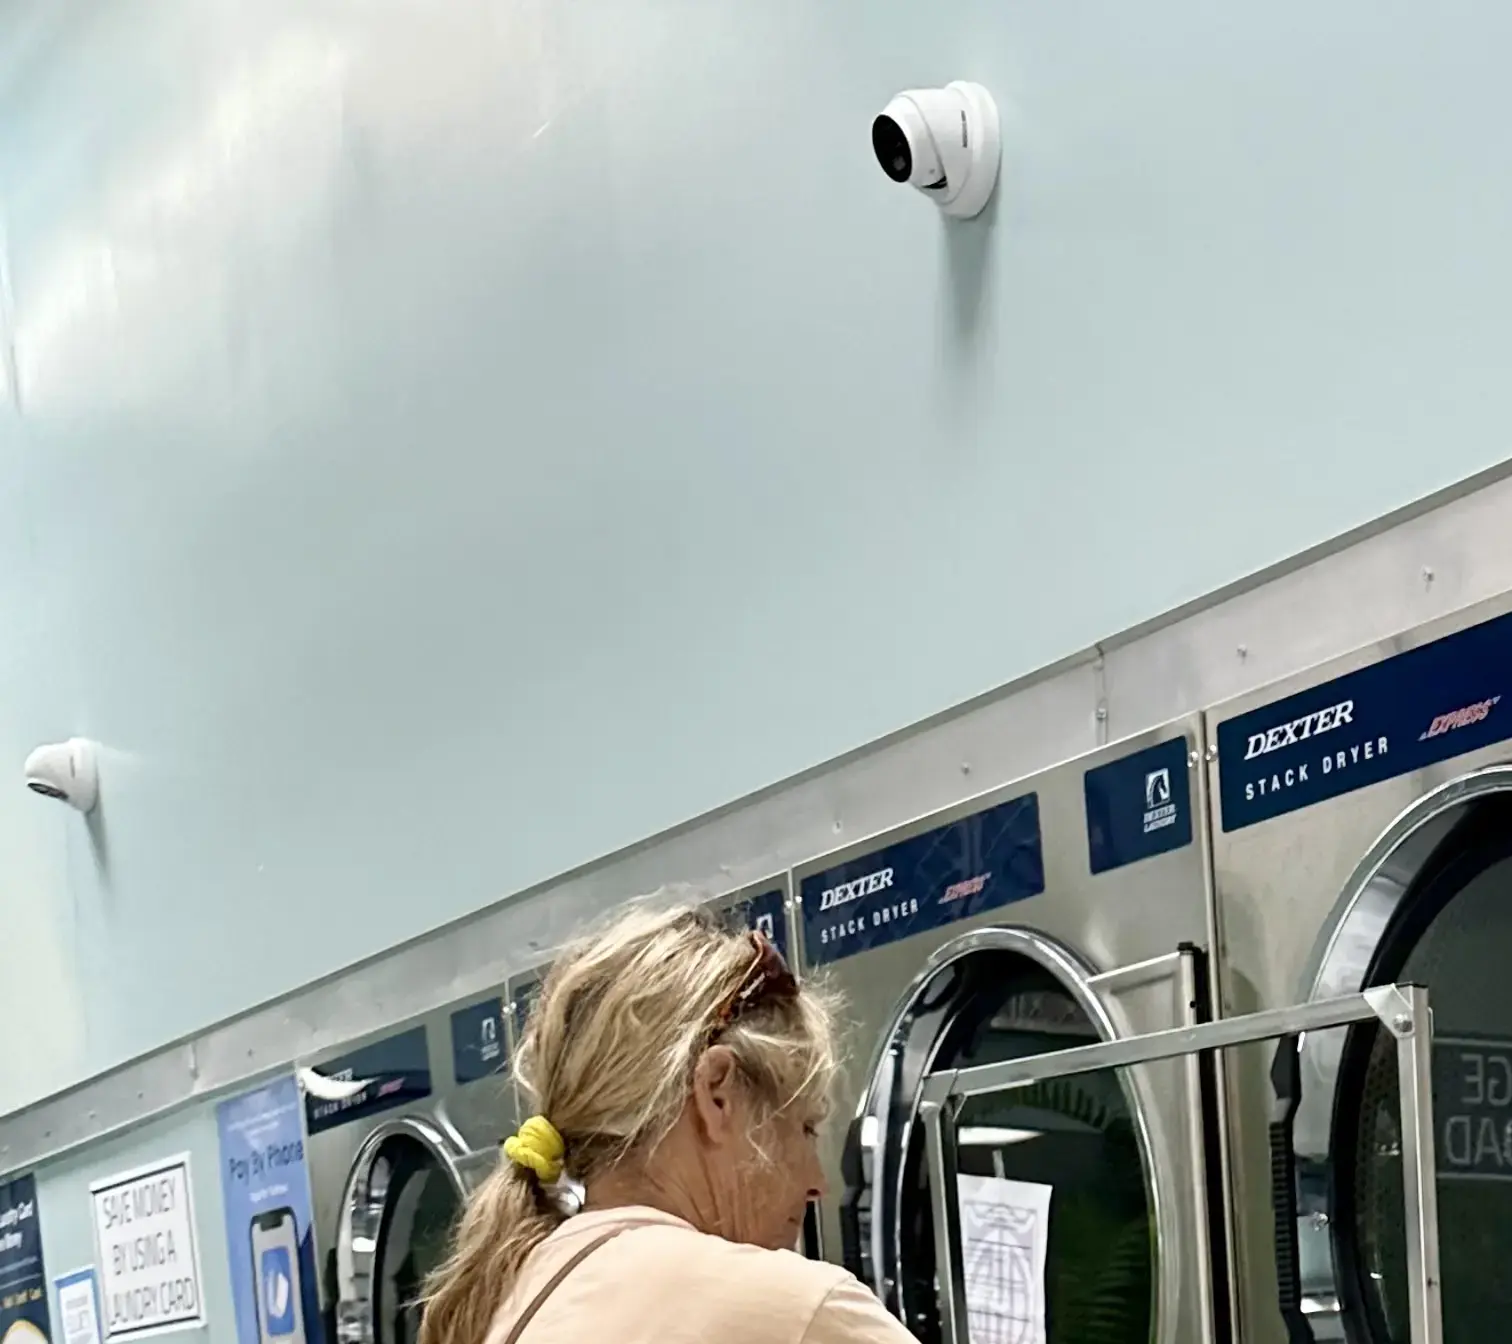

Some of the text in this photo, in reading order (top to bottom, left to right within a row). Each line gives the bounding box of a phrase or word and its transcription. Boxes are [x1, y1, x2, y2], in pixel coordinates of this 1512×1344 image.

[1244, 700, 1354, 760] DEXTER
[1427, 698, 1493, 738] EXPRESS
[1245, 737, 1388, 800] STACK DRYER
[819, 867, 894, 911] DEXTER
[821, 898, 918, 944] STACK DRYER
[228, 1157, 250, 1187] Pay
[267, 1139, 304, 1168] Phone
[103, 1175, 176, 1230] SAVE MONEY
[113, 1229, 179, 1276] BY USING A
[109, 1284, 158, 1326] LAUNDRY
[160, 1276, 195, 1315] CARD
